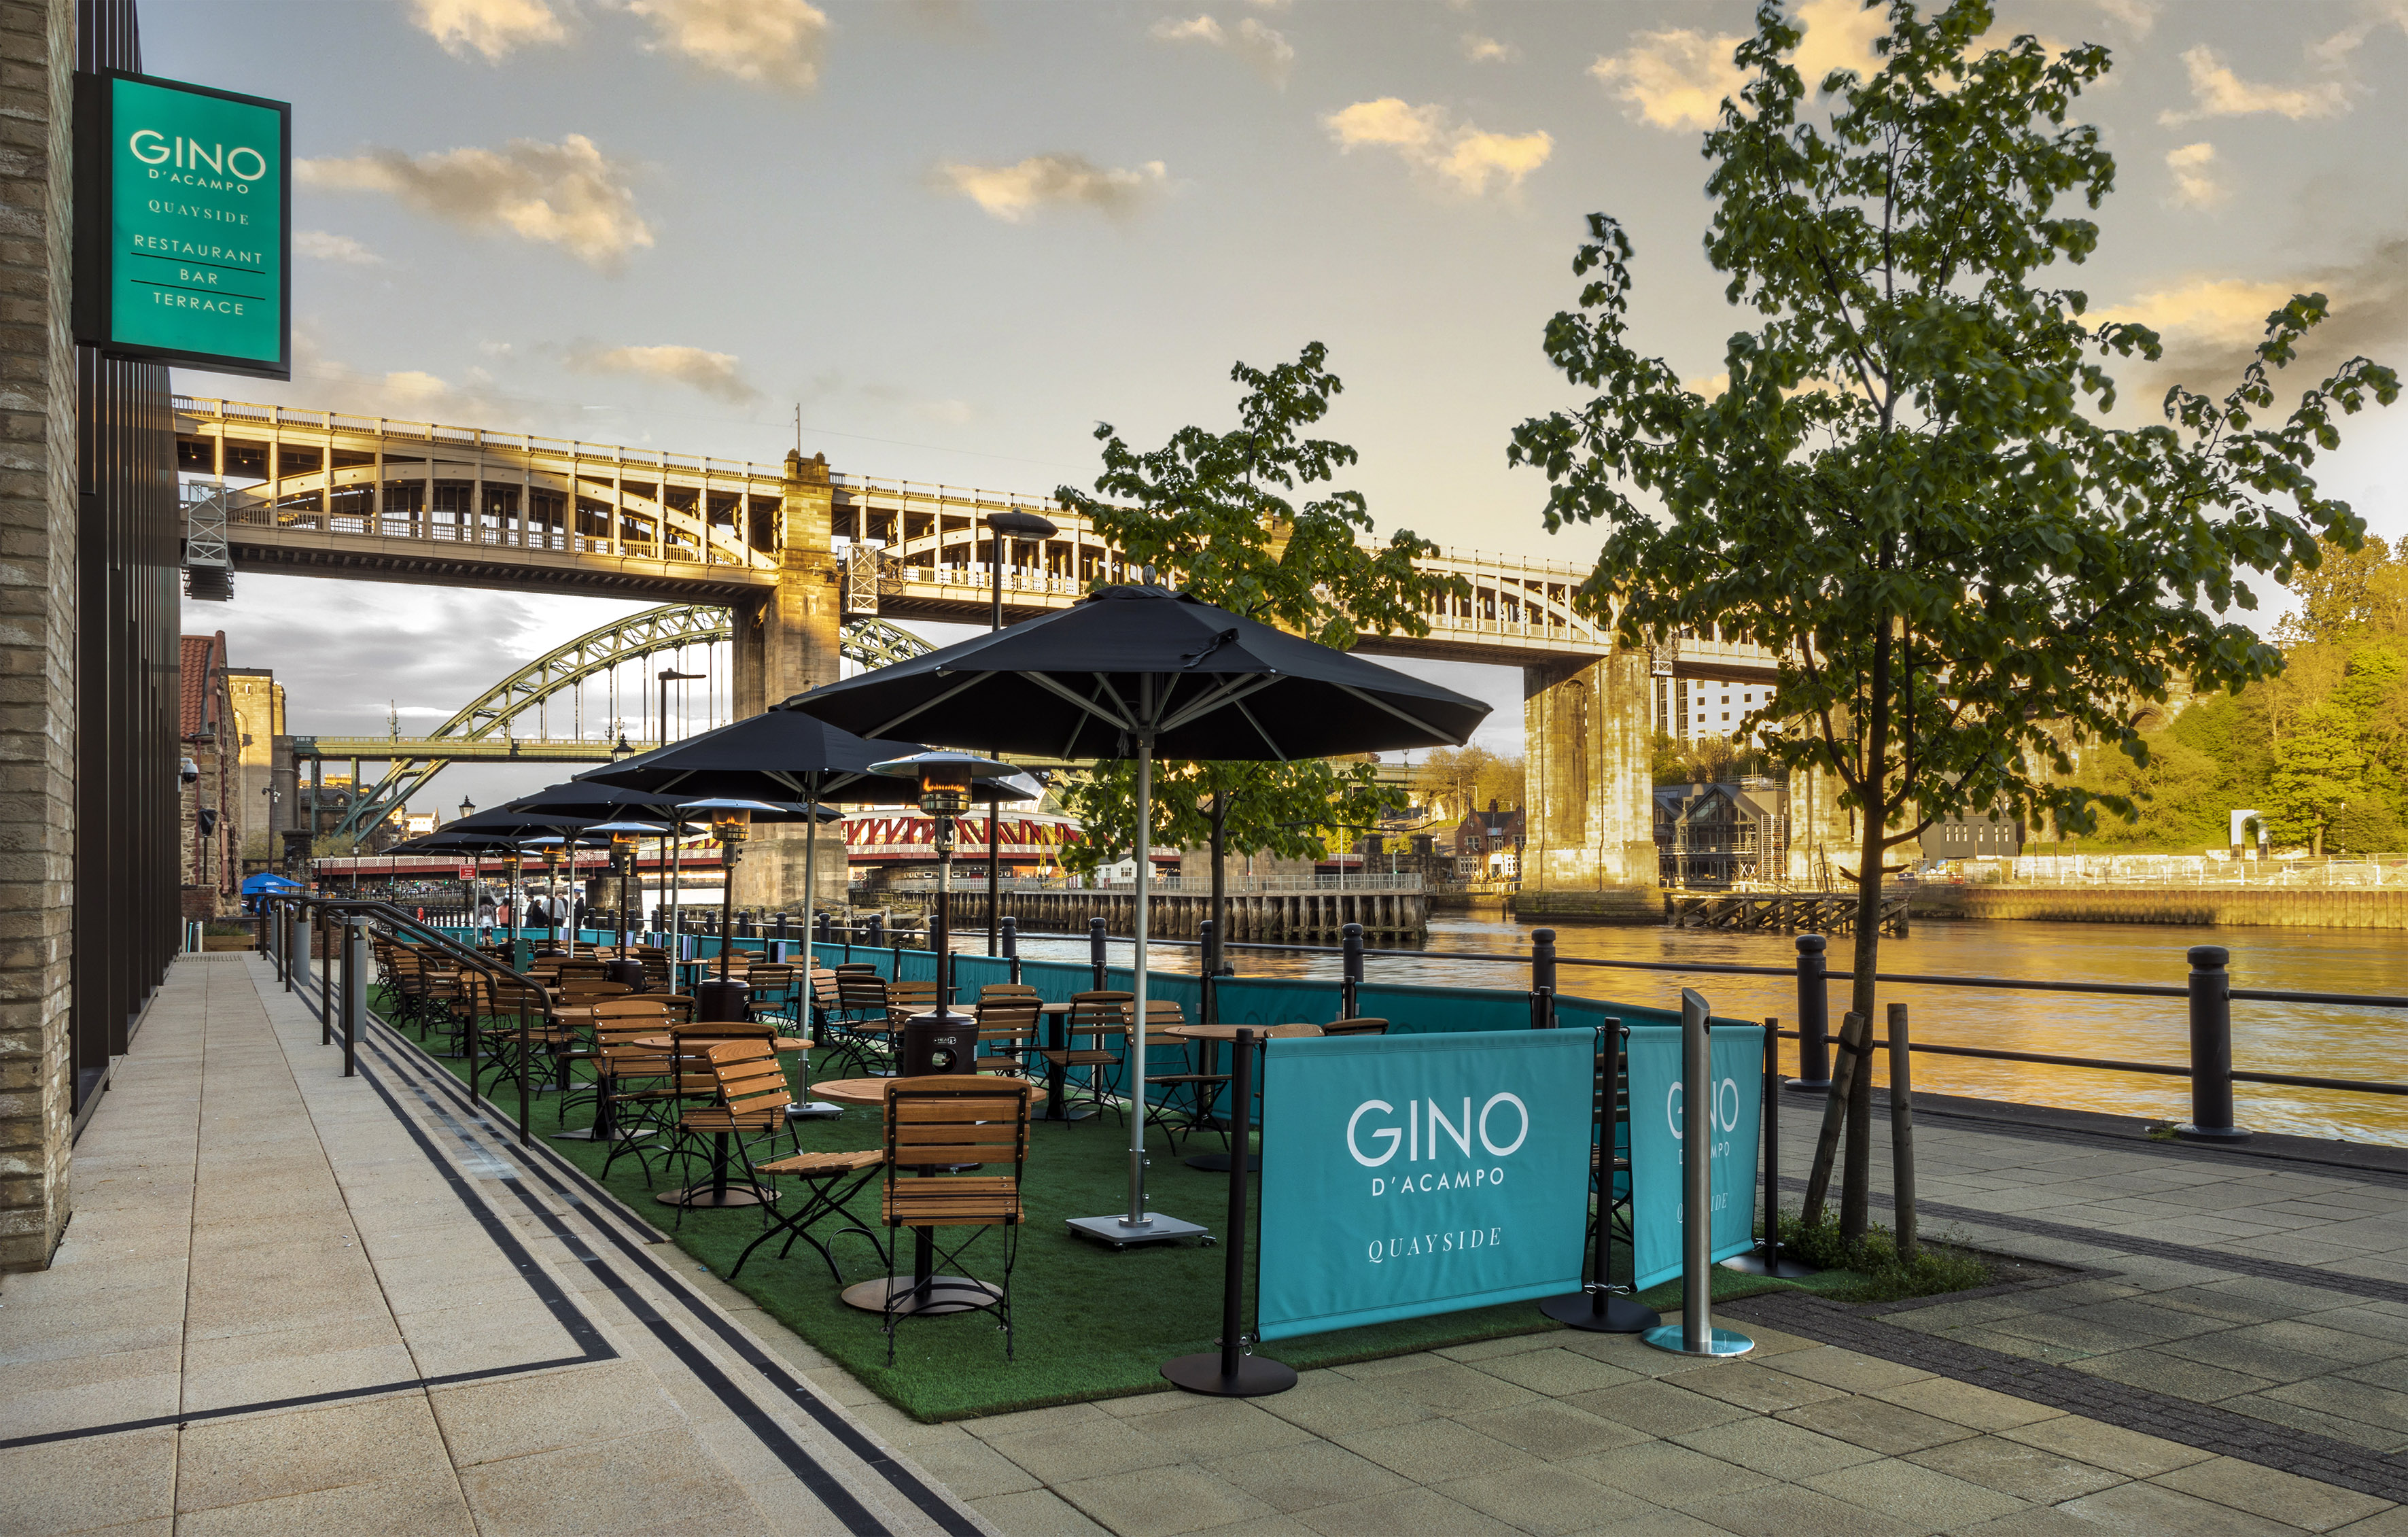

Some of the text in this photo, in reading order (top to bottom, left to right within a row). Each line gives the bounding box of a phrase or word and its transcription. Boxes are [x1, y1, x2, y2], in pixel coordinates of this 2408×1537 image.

[130, 129, 266, 181] GINO
[149, 169, 249, 194] D'ACAMPO
[148, 200, 249, 225] QUAYSIDE
[135, 235, 262, 264] RESTAURANT
[180, 269, 217, 285] BAR
[154, 292, 244, 315] TERRACE
[1667, 1077, 1739, 1139] GO
[1346, 1092, 1529, 1167] GINO
[1679, 1141, 1730, 1164] DMPO
[1372, 1167, 1504, 1196] D'ACAMPO
[1677, 1192, 1728, 1224] QIDE
[1368, 1227, 1501, 1264] QUAYSIDE
